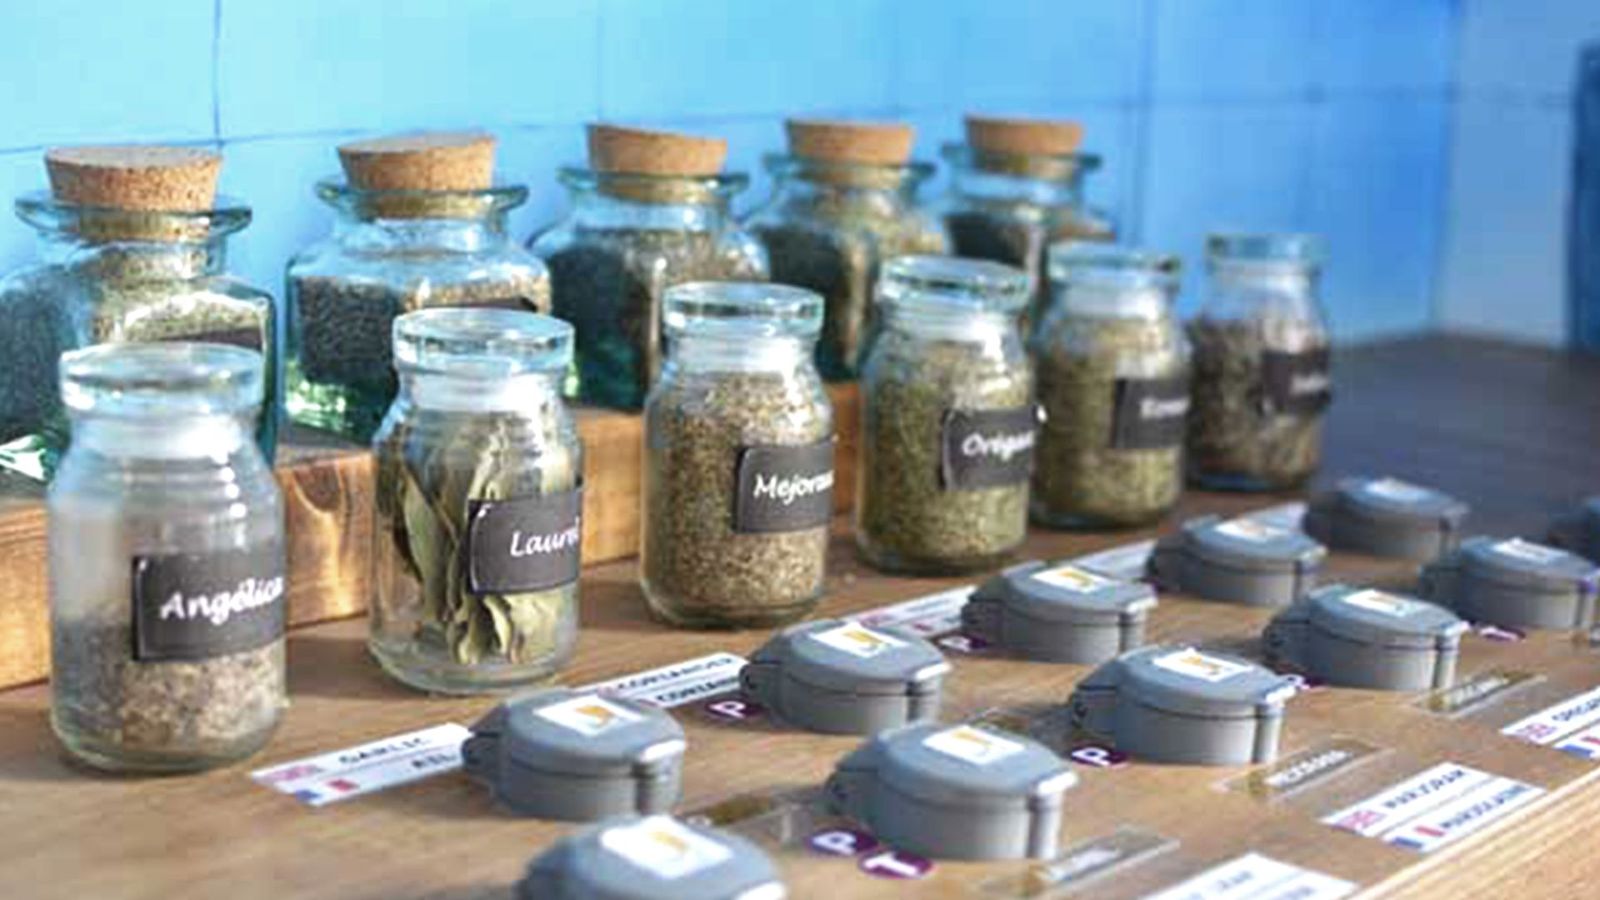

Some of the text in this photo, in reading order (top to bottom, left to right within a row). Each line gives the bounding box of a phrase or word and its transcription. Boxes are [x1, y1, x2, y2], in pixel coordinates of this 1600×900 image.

[708, 701, 746, 719] P
[1071, 747, 1111, 767] P
[812, 830, 857, 856] P
[864, 852, 918, 876] T
